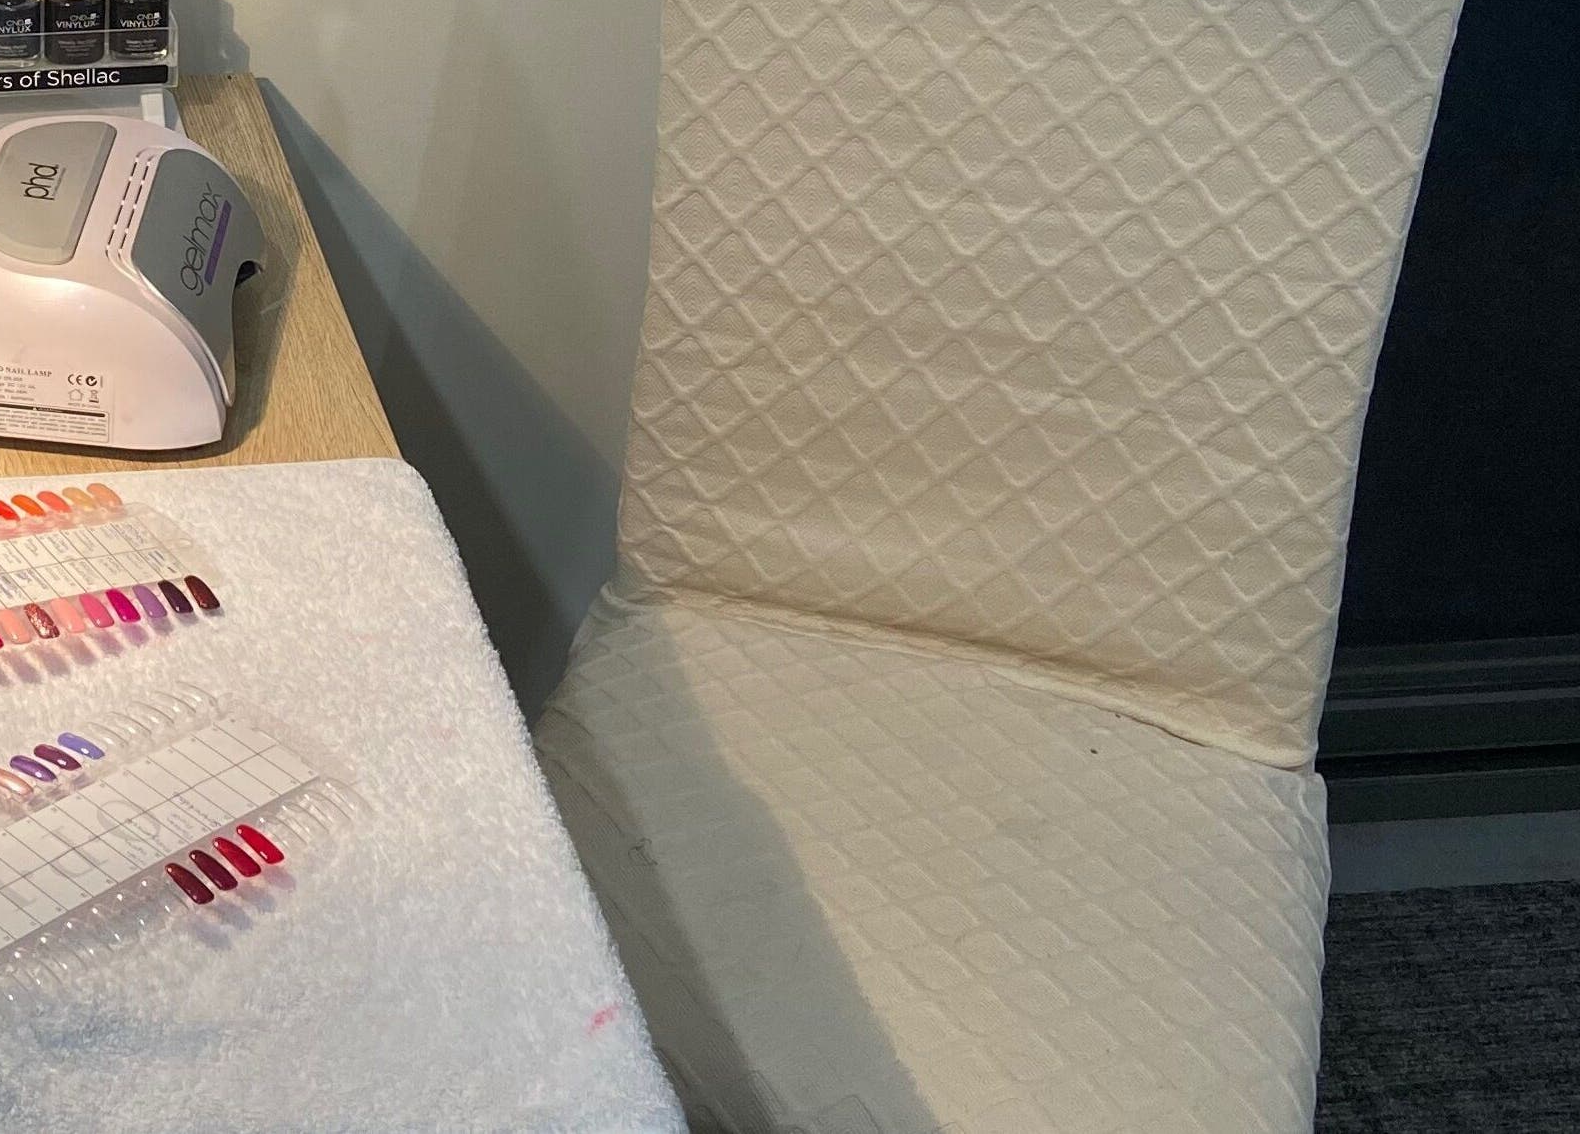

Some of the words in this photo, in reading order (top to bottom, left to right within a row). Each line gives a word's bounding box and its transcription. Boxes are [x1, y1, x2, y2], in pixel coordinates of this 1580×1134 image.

[56, 20, 96, 29] VINYLUX
[120, 19, 160, 28] VINYLUX
[19, 71, 41, 88] of
[47, 68, 121, 86] Shellac
[21, 162, 59, 201] phd
[5, 366, 25, 375] NAIL
[27, 368, 53, 378] LAMP
